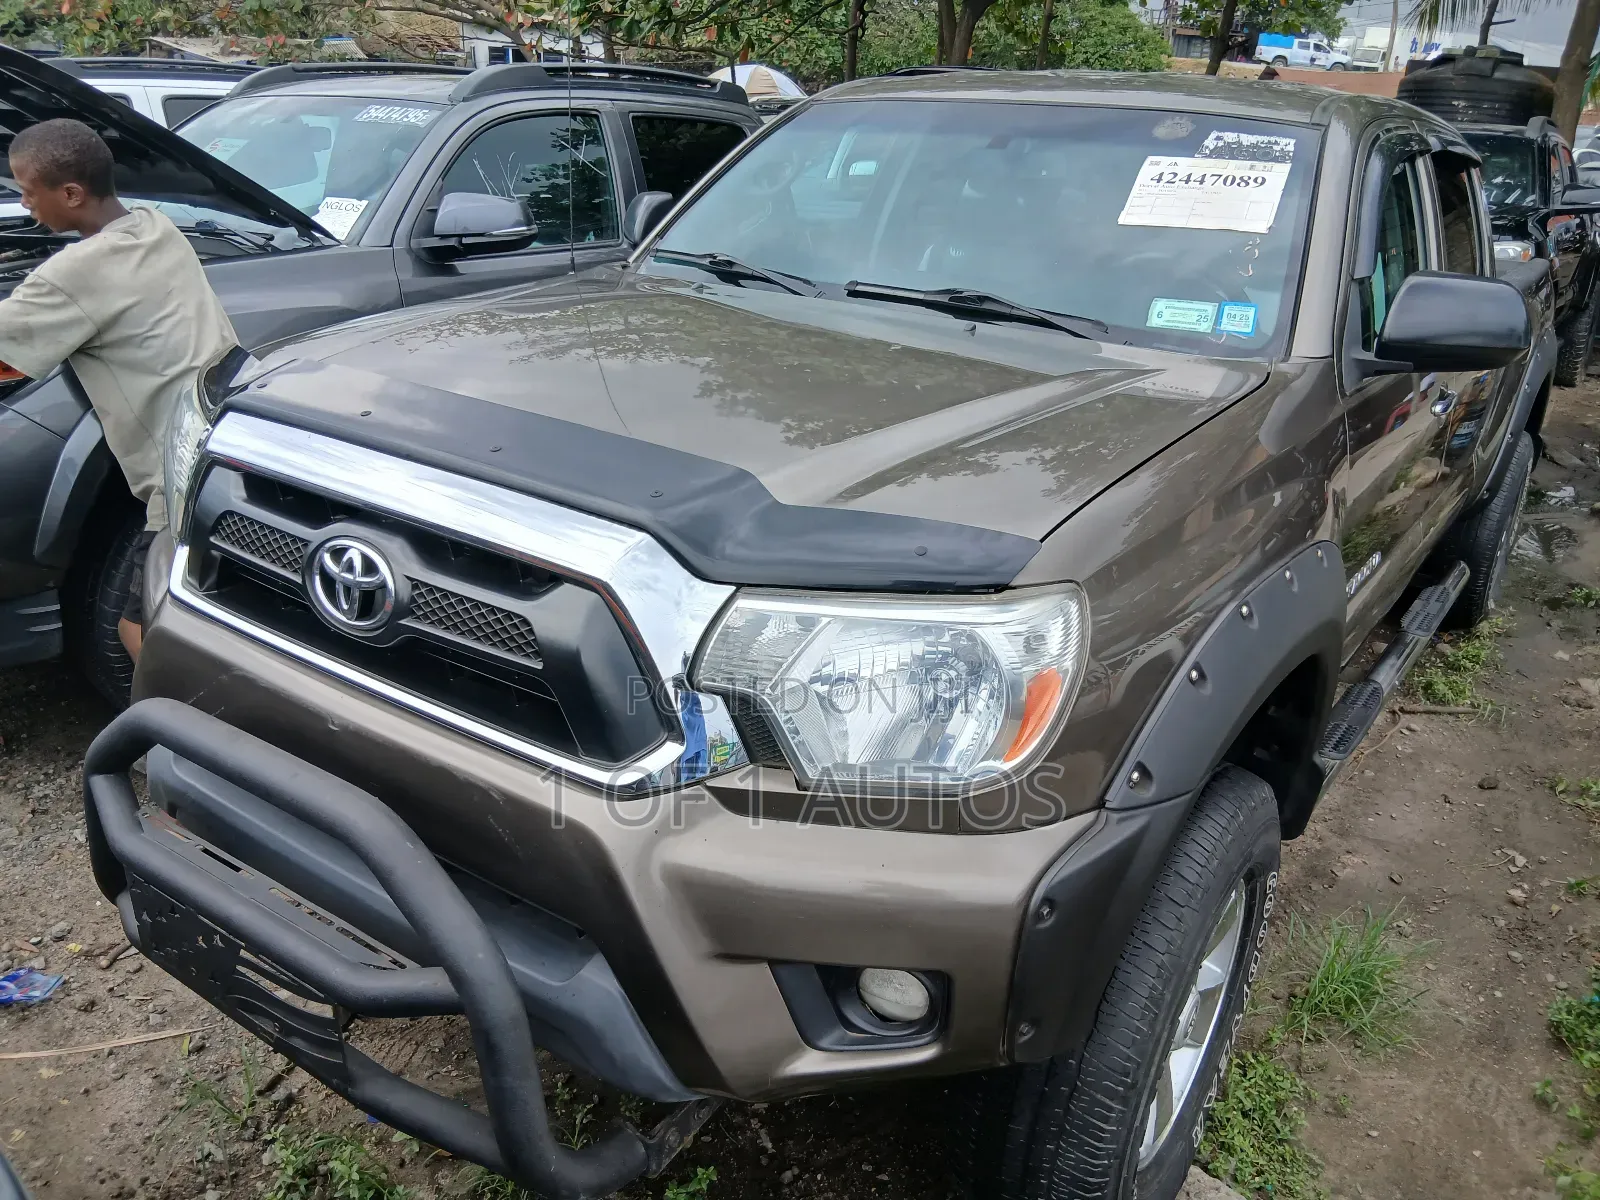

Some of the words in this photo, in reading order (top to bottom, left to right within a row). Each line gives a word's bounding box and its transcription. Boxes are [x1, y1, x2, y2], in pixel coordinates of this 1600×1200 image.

[1150, 171, 1267, 189] 42447089
[321, 201, 362, 213] NGLOS
[1156, 310, 1164, 319] 6
[1196, 314, 1210, 323] 25
[1226, 312, 1237, 320] 04
[1239, 313, 1250, 321] 25
